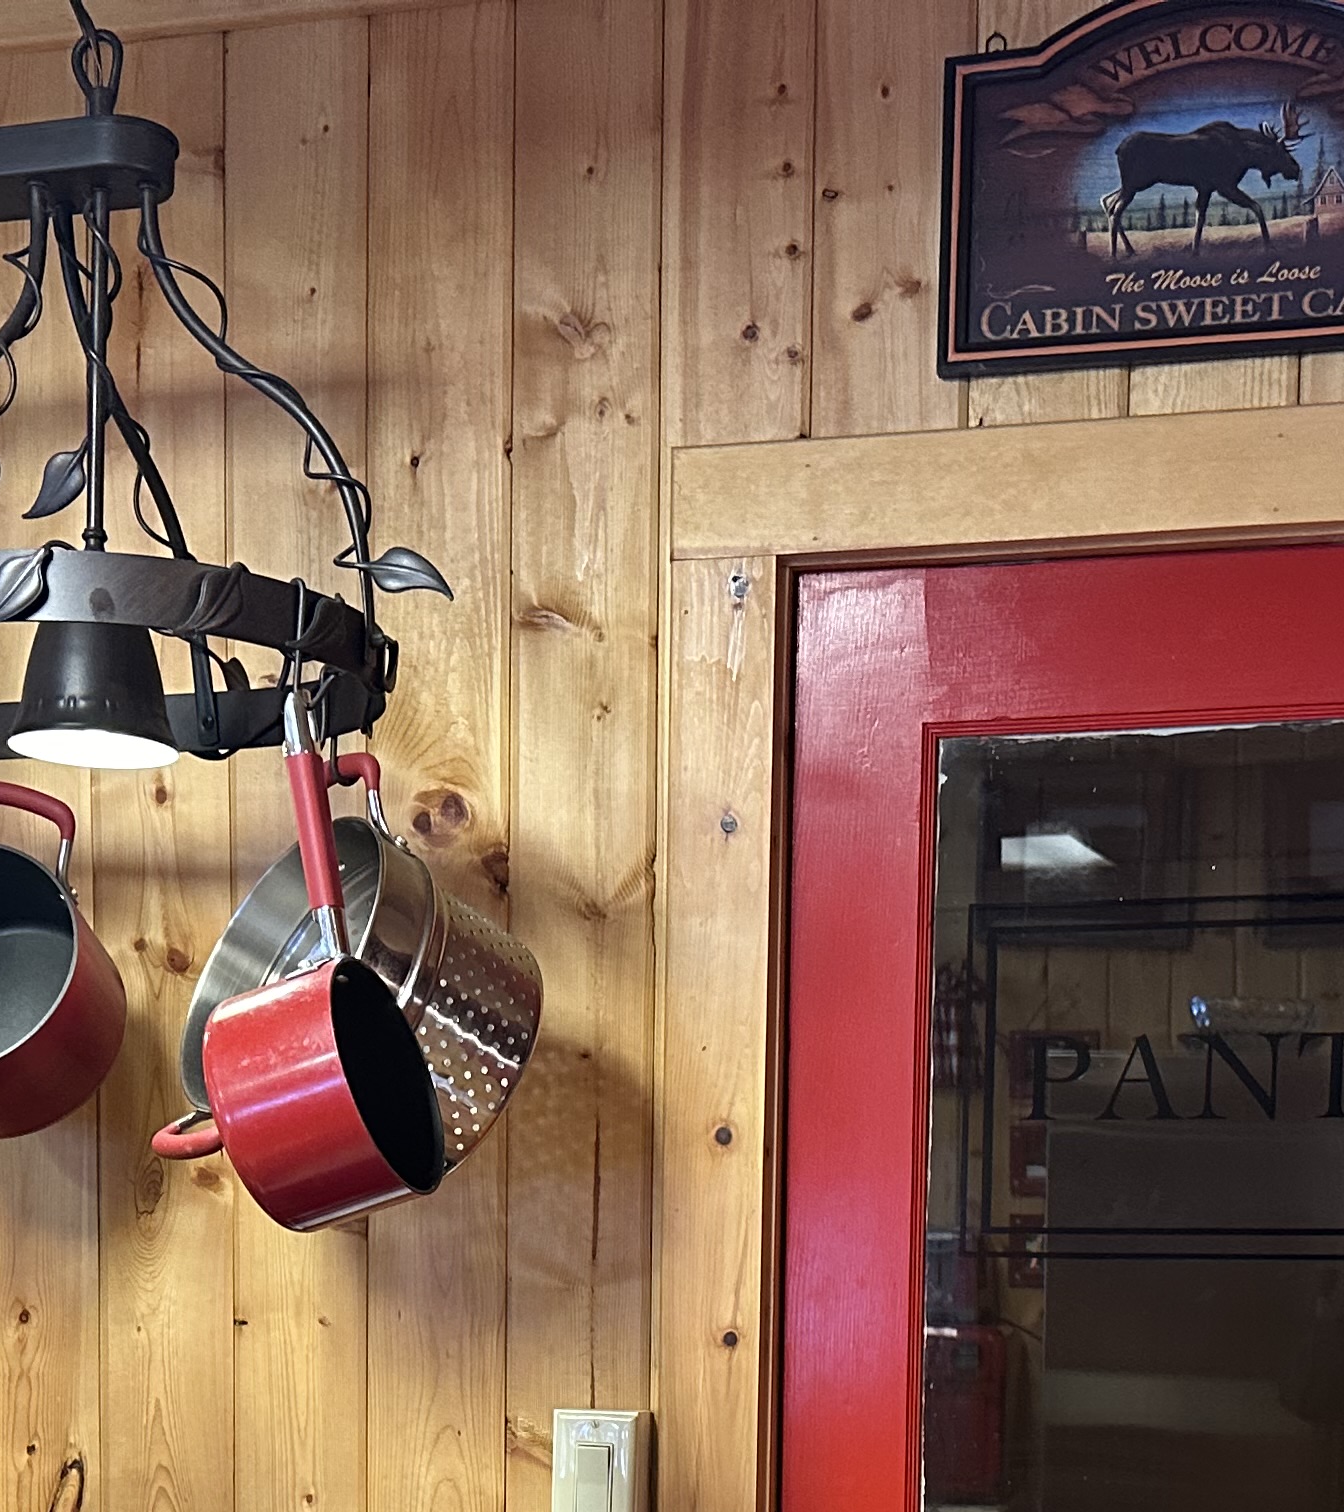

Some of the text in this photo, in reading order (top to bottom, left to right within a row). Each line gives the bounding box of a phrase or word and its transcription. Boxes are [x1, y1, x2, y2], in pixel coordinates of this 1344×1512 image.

[1089, 22, 1336, 84] WELCOME
[1106, 260, 1322, 295] The Moose is Loose
[980, 301, 1124, 341] CABIN
[1133, 290, 1294, 331] SWEET
